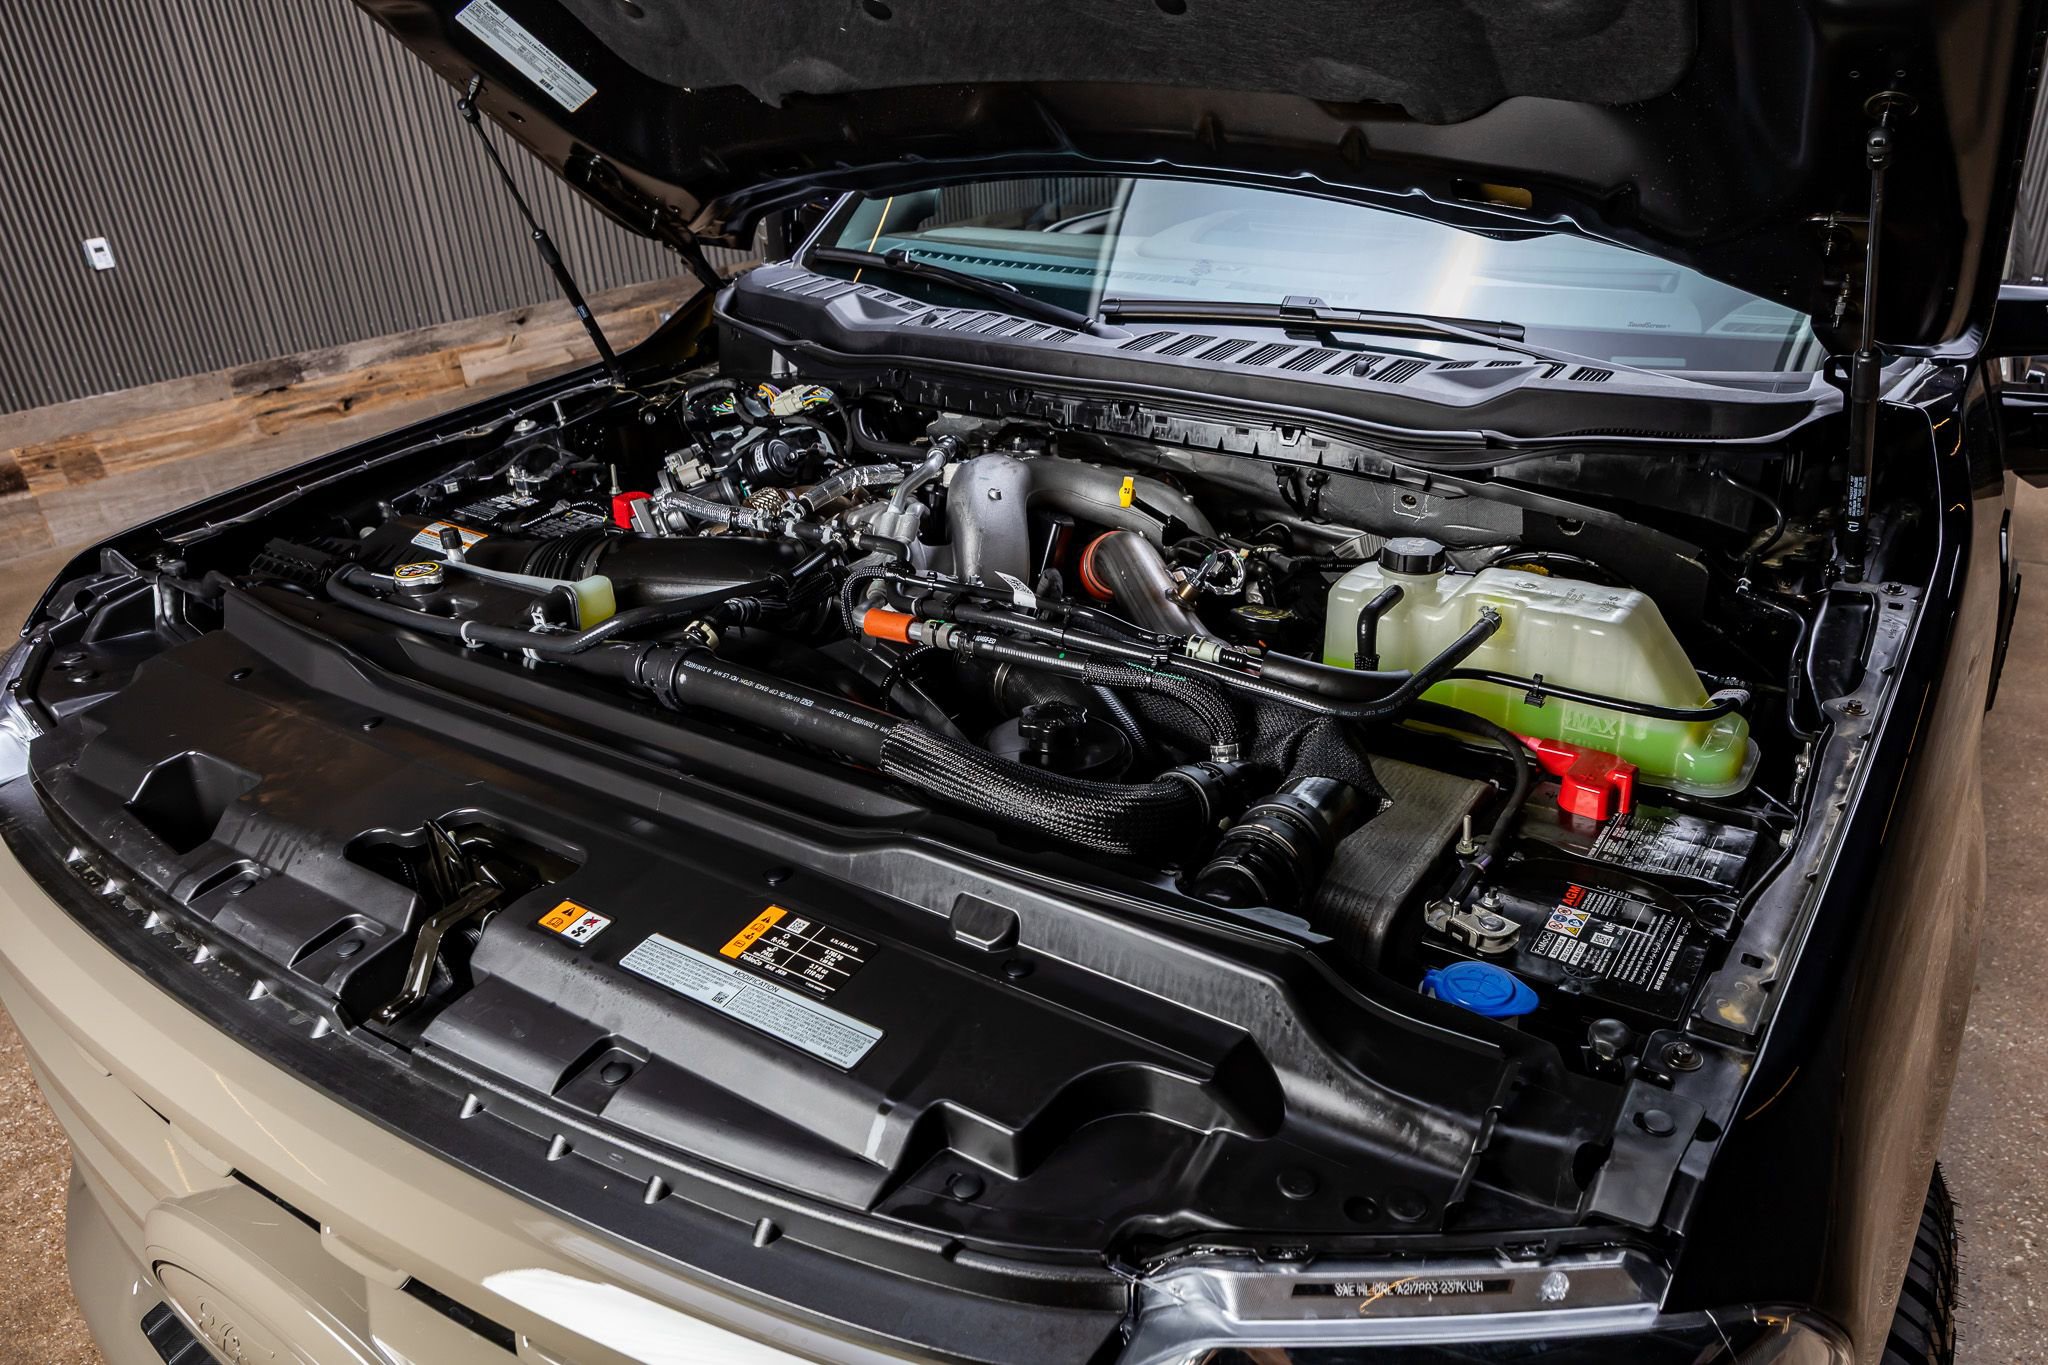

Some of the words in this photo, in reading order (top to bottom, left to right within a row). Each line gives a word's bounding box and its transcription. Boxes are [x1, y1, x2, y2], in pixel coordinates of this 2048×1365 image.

[1560, 884, 1582, 906] AGM
[1533, 930, 1554, 954] FoMoCo
[730, 969, 781, 993] MODIFICATION
[1334, 1282, 1356, 1297] SAE
